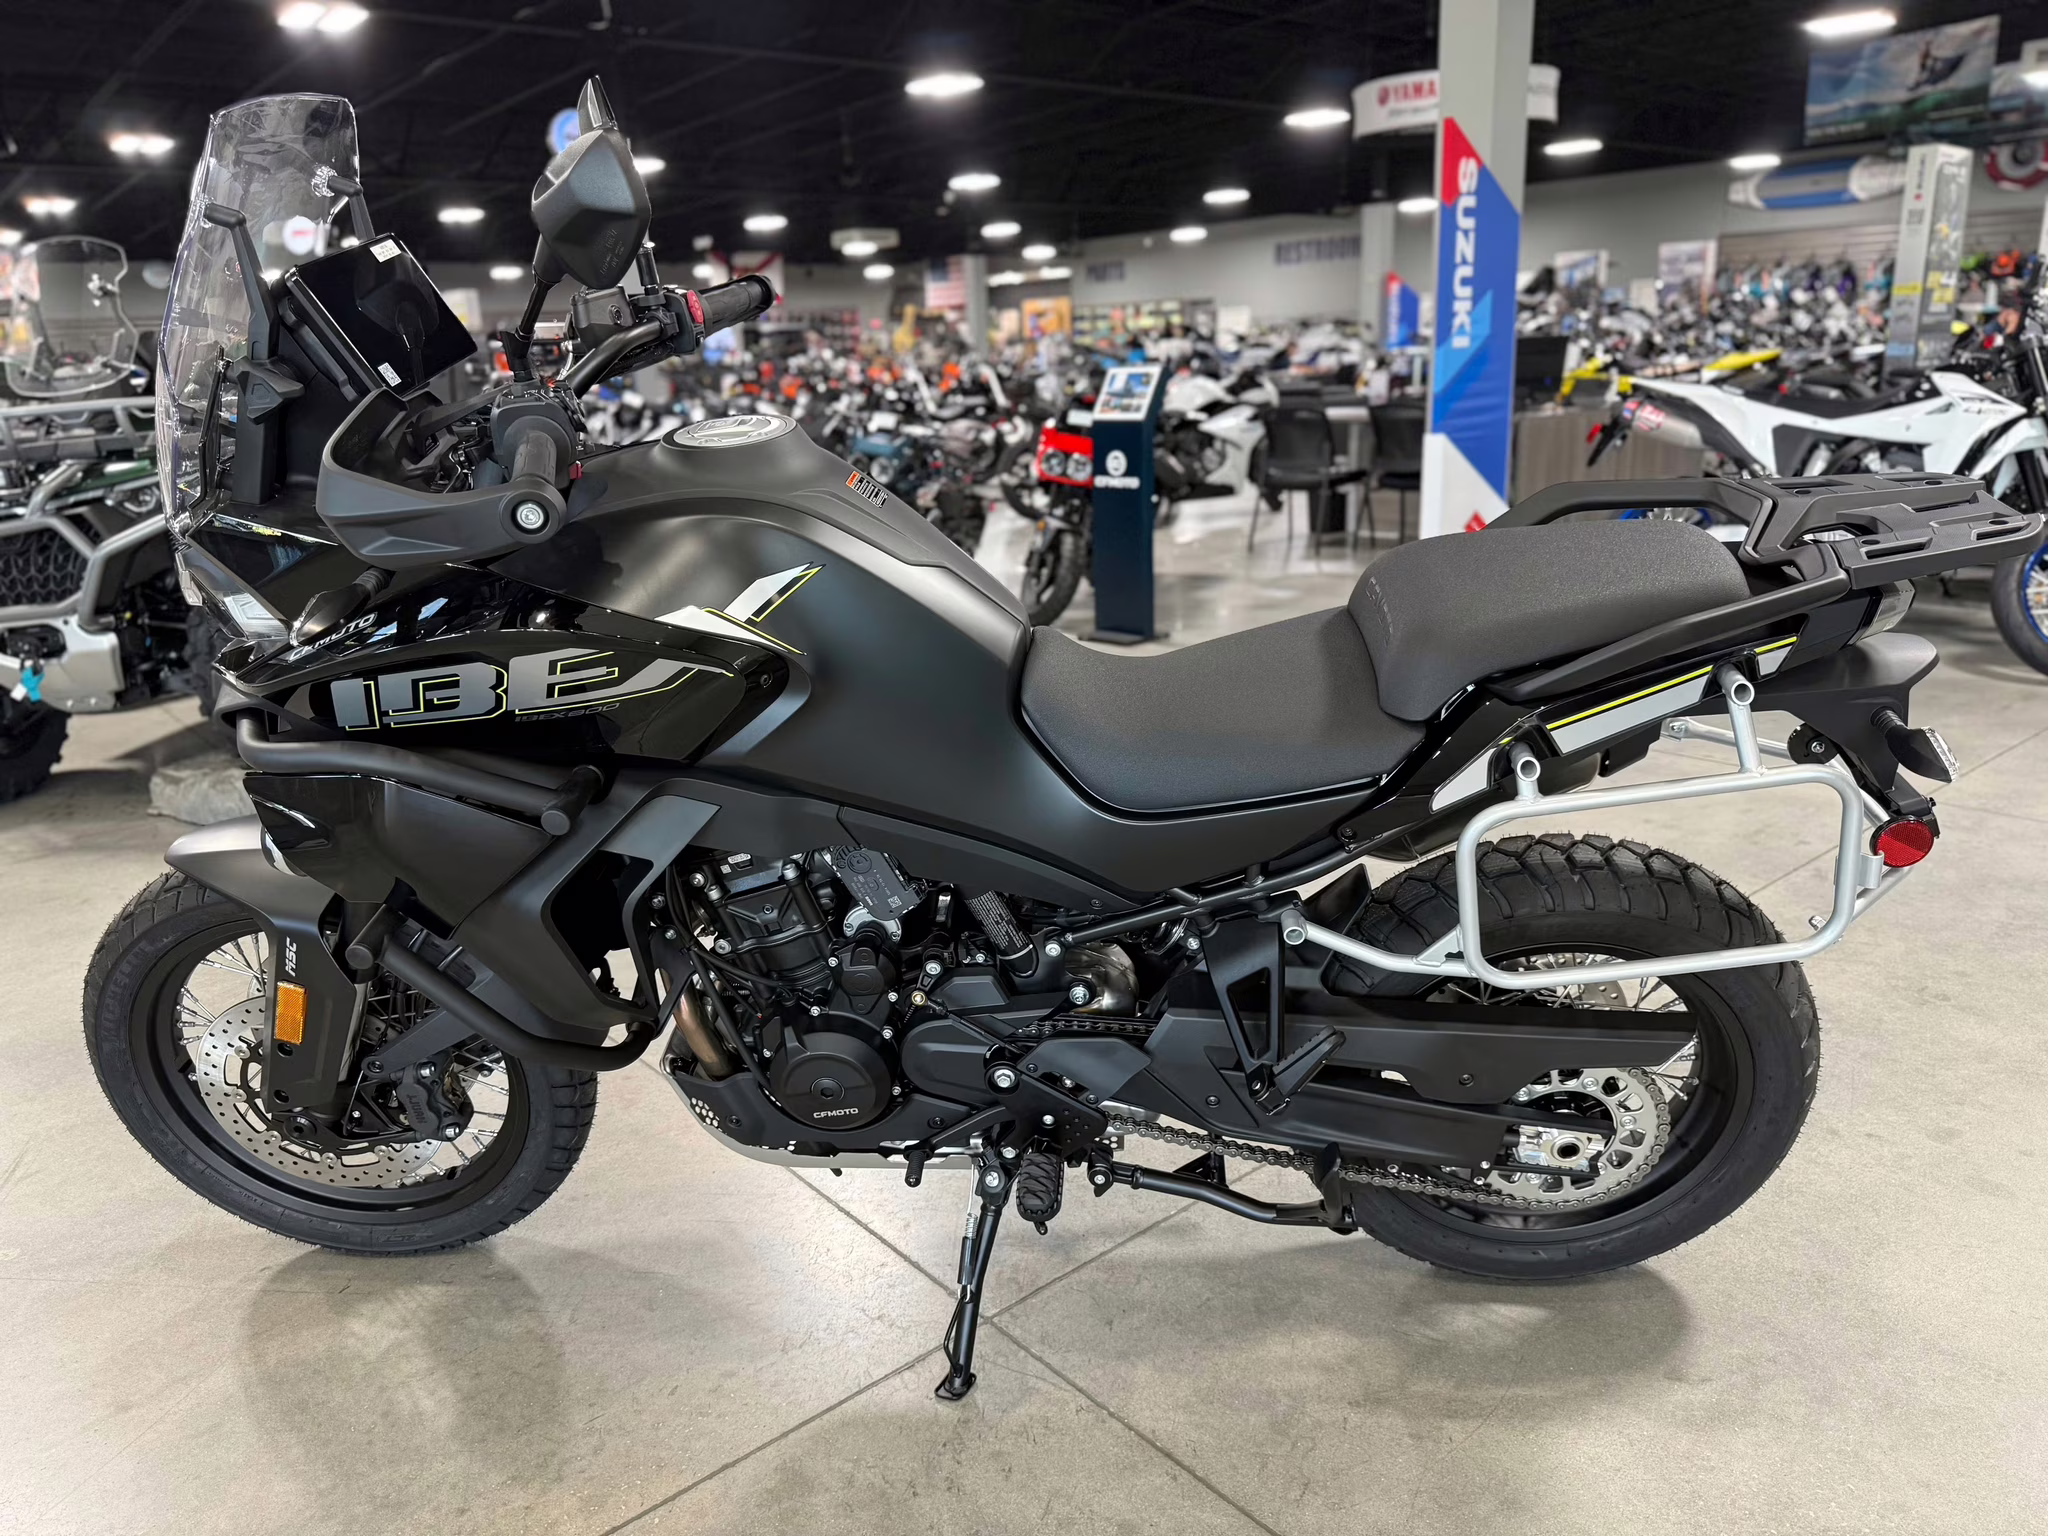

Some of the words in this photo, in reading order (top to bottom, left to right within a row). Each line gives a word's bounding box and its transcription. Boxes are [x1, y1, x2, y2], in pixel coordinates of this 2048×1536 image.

[1452, 156, 1479, 348] SUZUKI
[285, 936, 297, 977] MSC
[812, 1106, 860, 1119] CFMOTO
